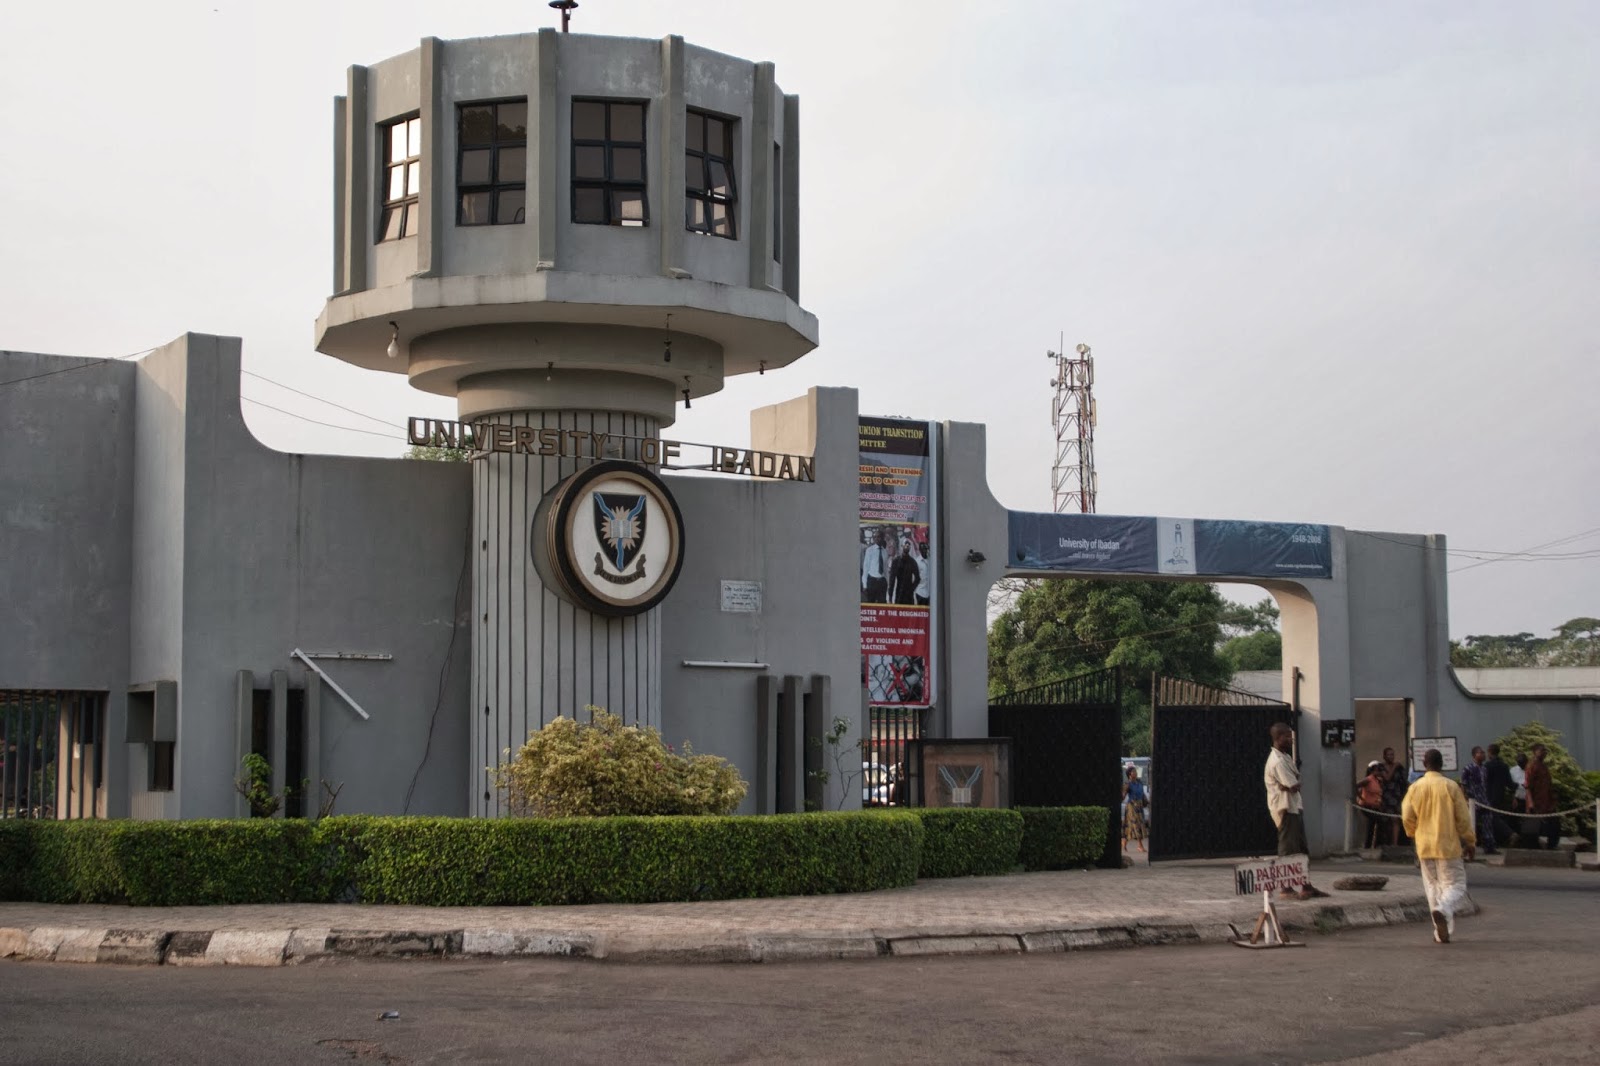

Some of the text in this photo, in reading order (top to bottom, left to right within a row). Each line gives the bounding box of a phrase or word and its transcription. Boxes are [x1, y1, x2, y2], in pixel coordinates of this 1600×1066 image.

[859, 425, 924, 439] UNION TRANSITION
[408, 417, 815, 482] UNIVERSITY OF IBADAN
[875, 466, 888, 474] AND
[889, 467, 923, 476] RETURNING
[883, 478, 908, 486] CAMPUS
[1059, 537, 1120, 551] University of Ibadan
[1238, 862, 1303, 896] NO PARKING
